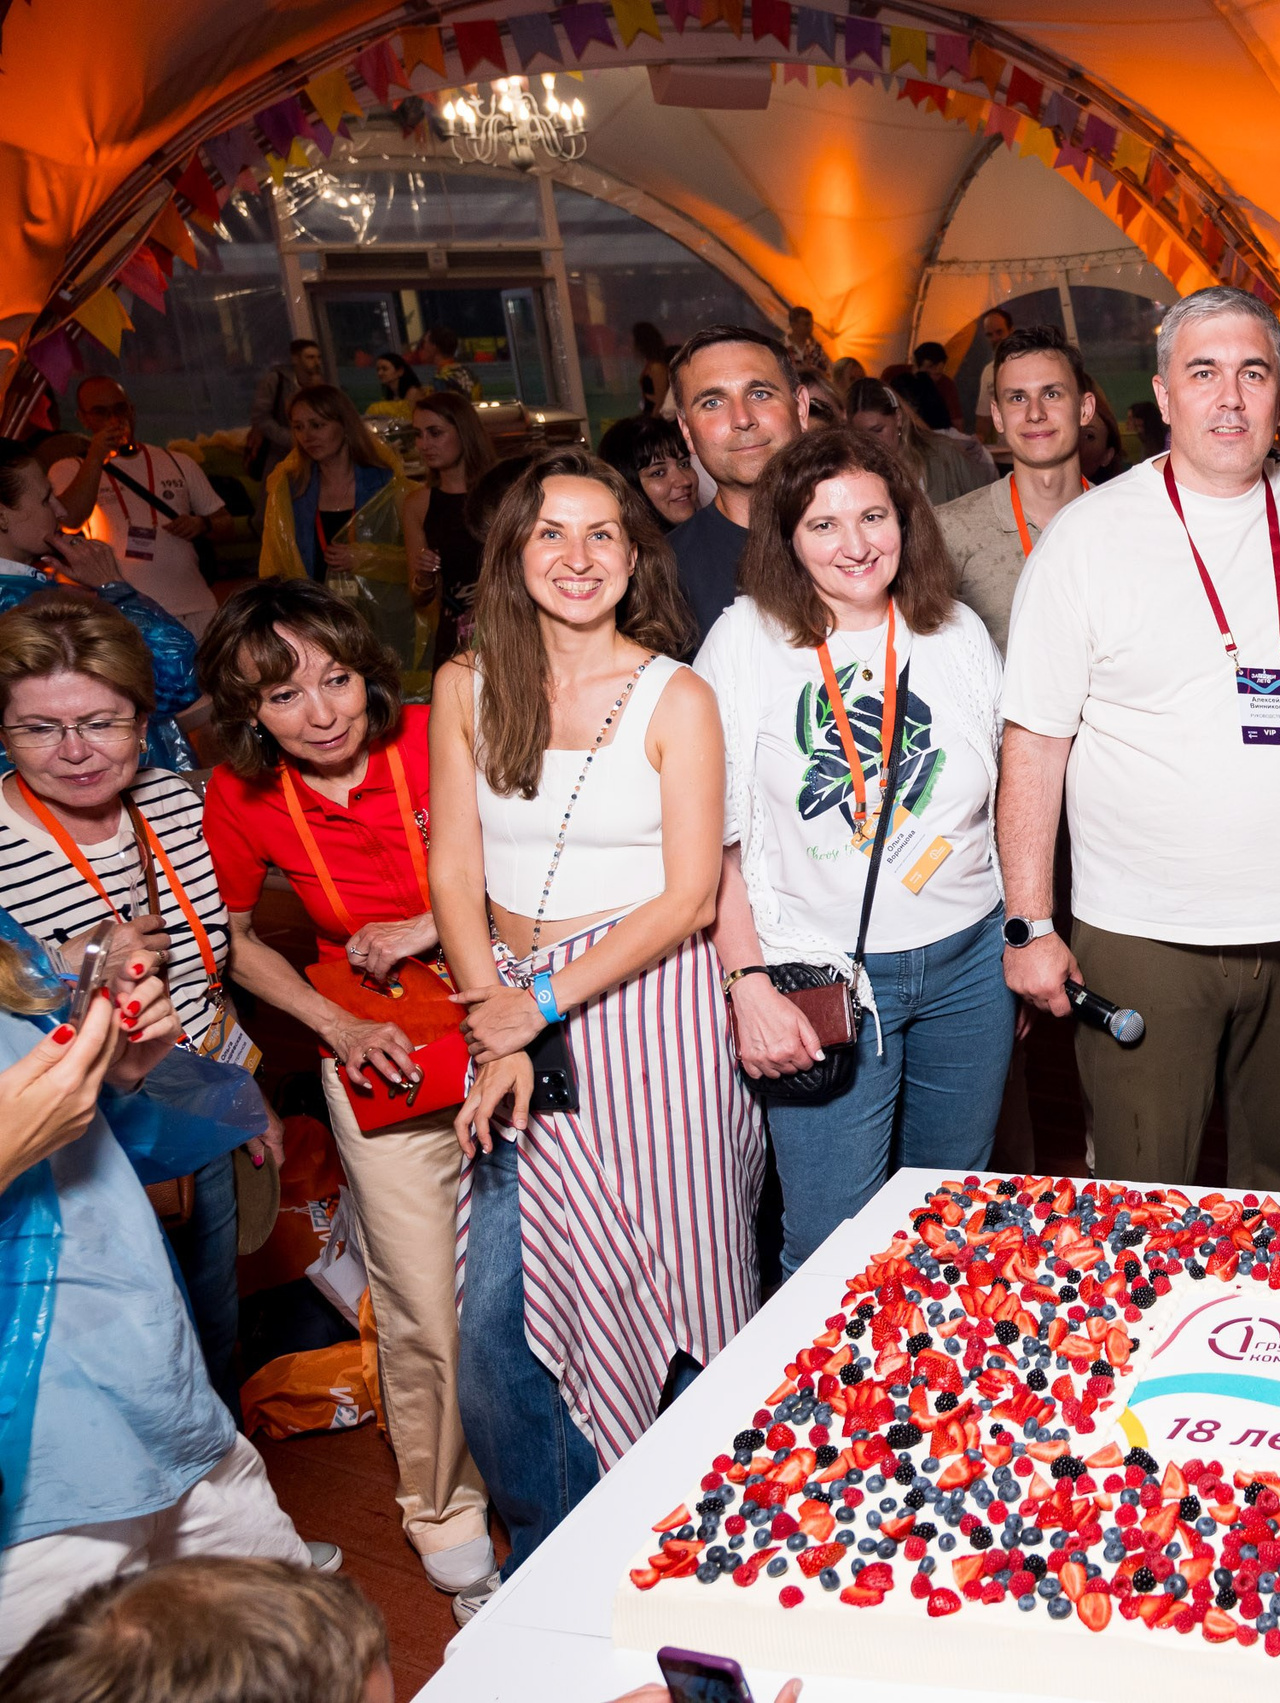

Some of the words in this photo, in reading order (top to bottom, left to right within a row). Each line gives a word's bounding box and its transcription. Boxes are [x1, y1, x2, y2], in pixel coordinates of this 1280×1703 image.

[886, 829, 916, 864] Воронцова
[887, 831, 904, 853] Ольга
[1166, 1417, 1222, 1443] 18
